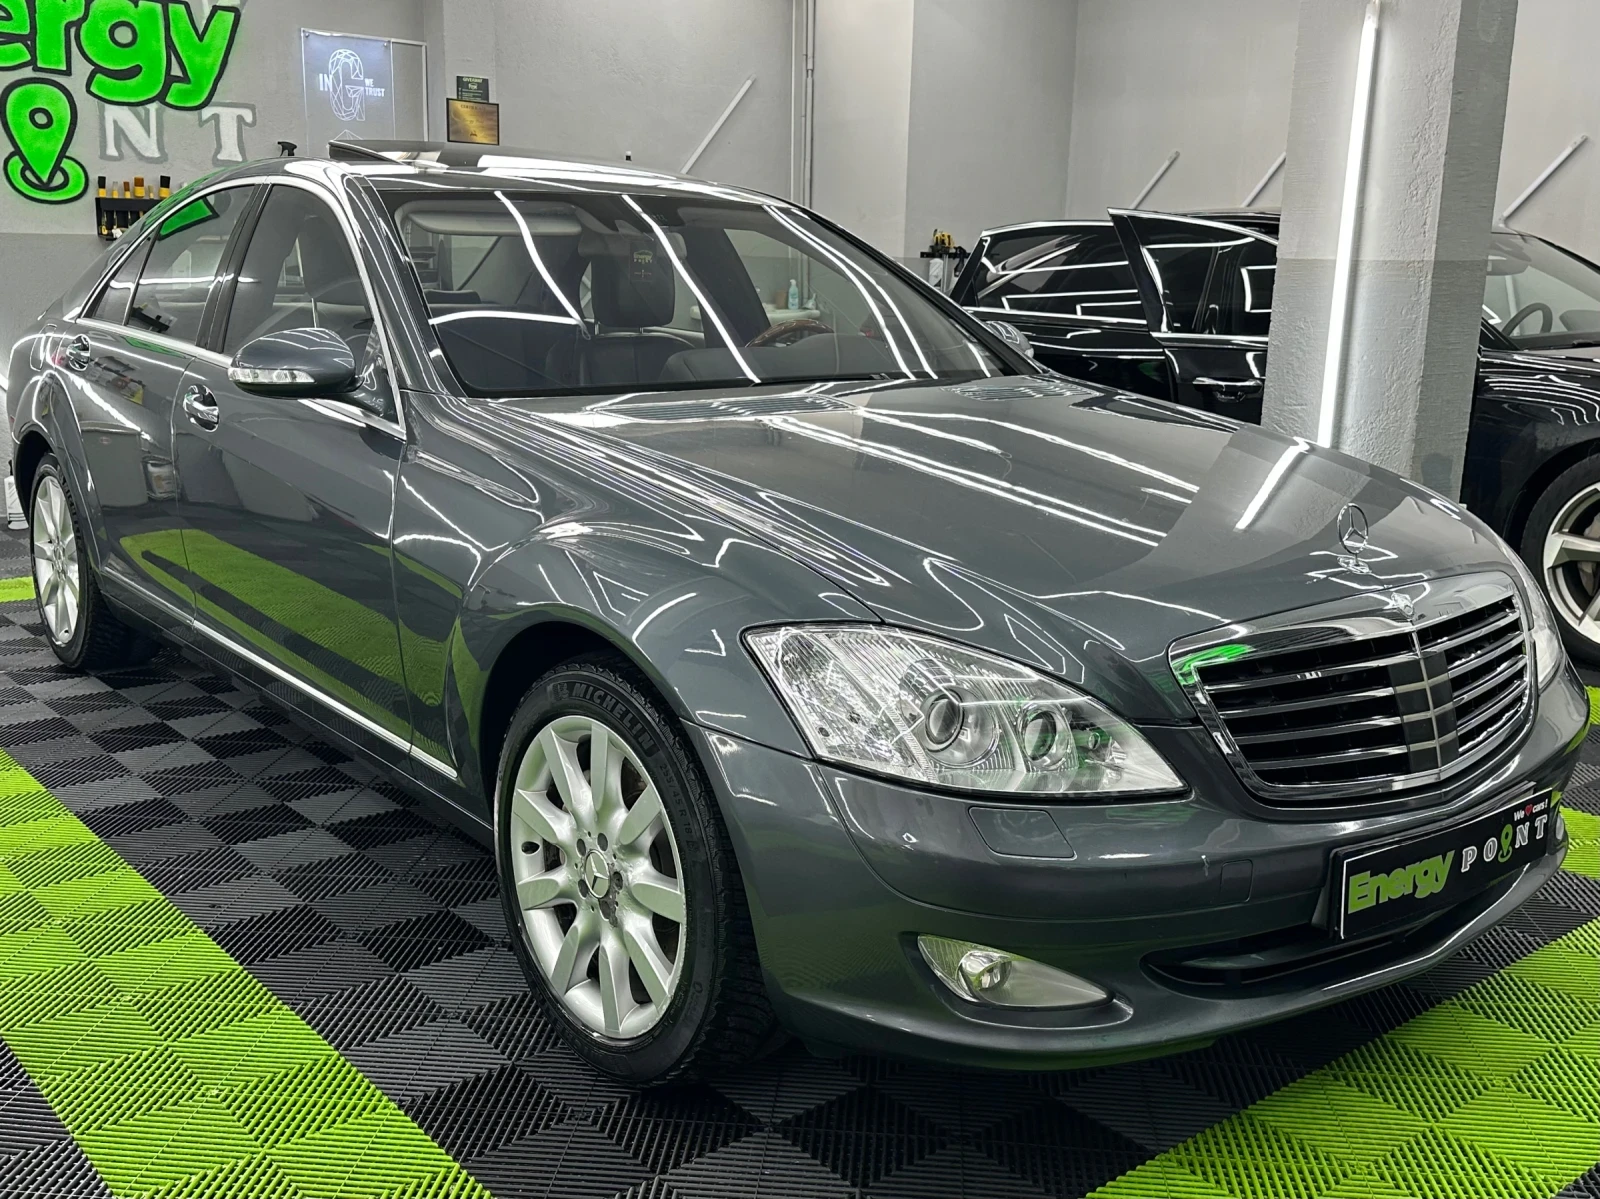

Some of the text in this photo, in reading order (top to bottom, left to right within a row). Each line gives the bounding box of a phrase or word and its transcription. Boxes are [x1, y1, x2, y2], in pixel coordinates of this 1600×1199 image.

[319, 73, 333, 92] IN
[364, 78, 374, 87] WE
[365, 87, 385, 97] TRUST
[572, 682, 656, 750] MICHELIN
[1348, 850, 1455, 914] Energy
